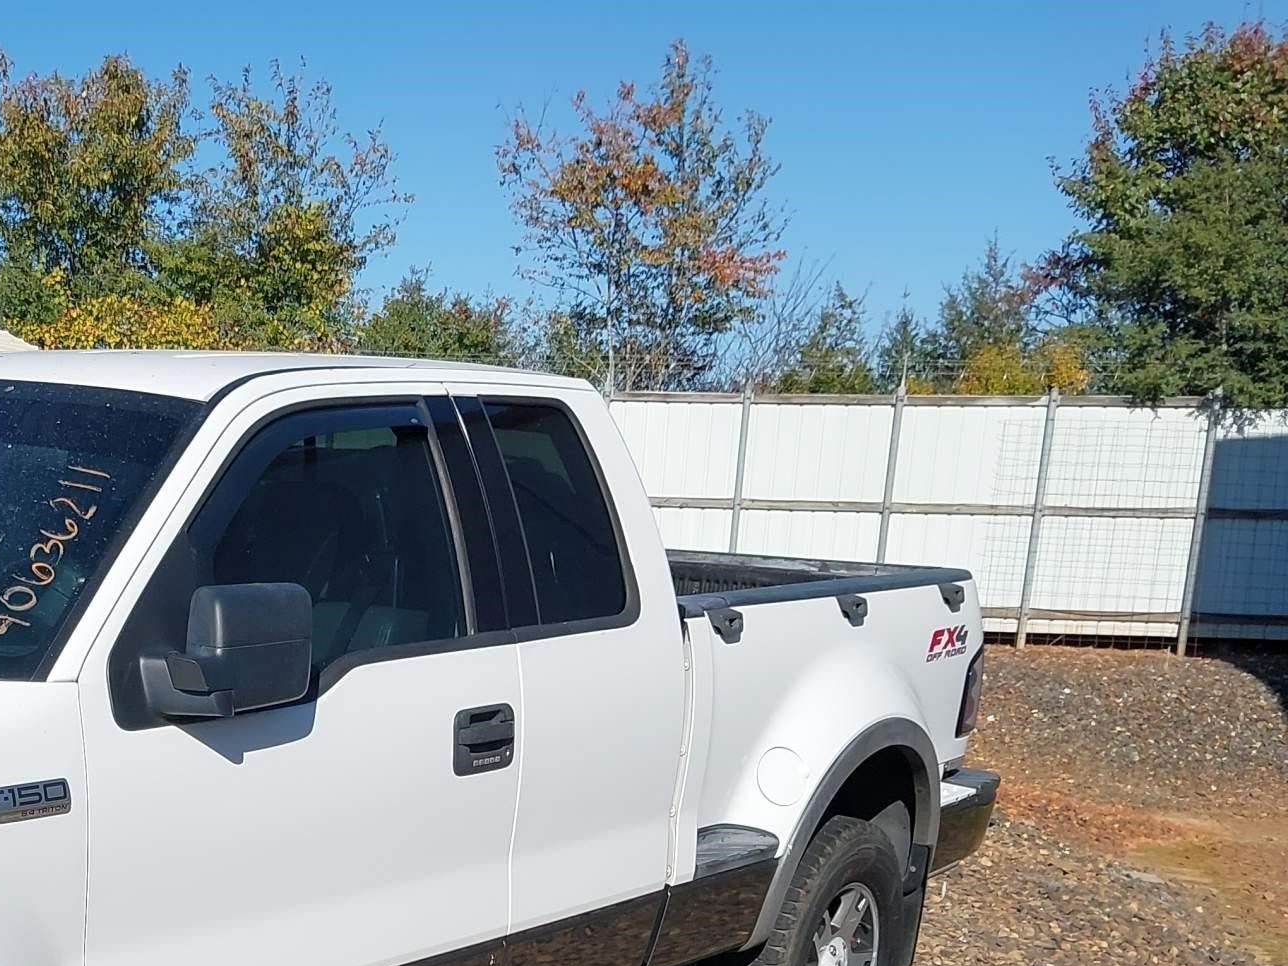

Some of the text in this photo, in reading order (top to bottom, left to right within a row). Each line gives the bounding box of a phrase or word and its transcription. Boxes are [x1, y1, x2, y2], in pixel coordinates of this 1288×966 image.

[928, 624, 968, 652] FX4
[926, 646, 967, 663] OFF ROAD
